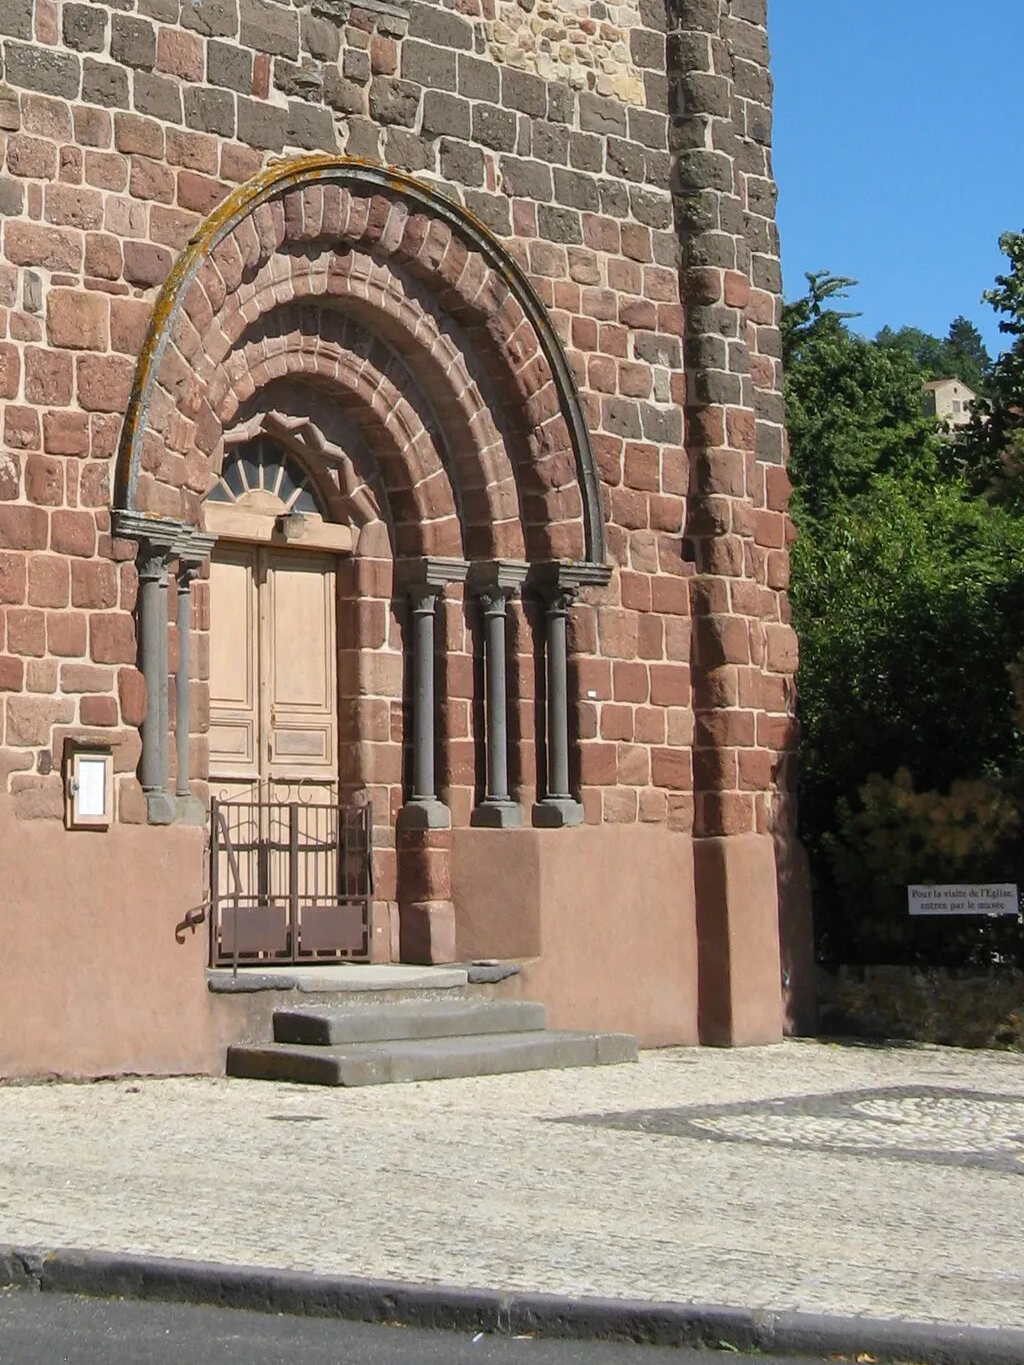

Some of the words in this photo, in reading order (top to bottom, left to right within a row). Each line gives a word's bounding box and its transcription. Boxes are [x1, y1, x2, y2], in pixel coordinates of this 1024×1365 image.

[912, 889, 932, 898] Pour
[933, 889, 942, 898] la
[944, 889, 967, 898] visite
[968, 888, 978, 897] de
[950, 902, 965, 911] par
[967, 900, 976, 909] le
